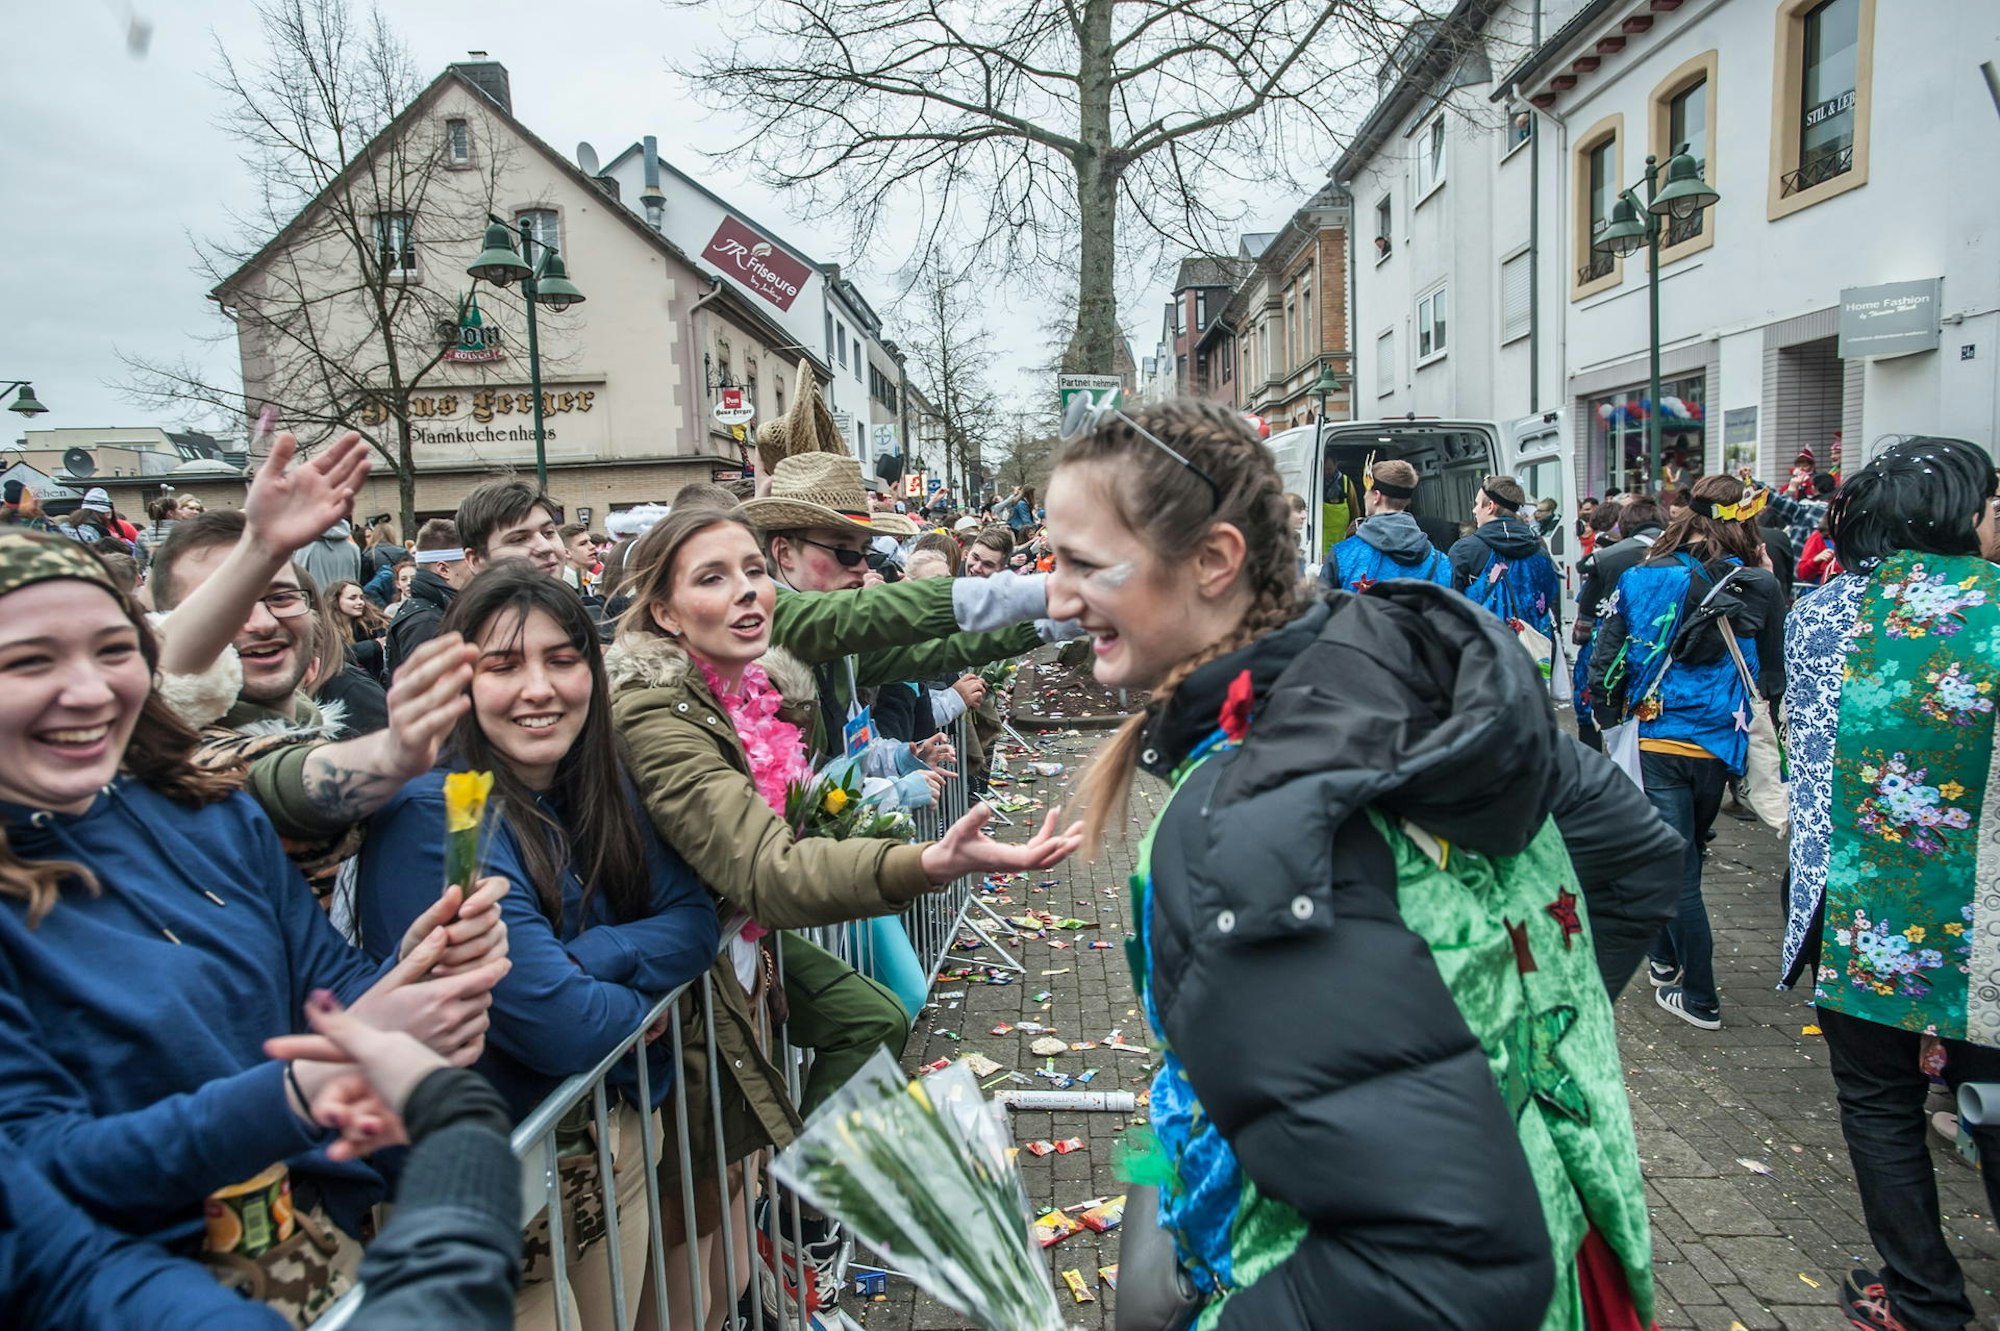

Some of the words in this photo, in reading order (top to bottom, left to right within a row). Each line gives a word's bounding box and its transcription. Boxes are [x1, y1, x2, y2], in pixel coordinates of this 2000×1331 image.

[1807, 106, 1827, 127] STIL
[1828, 101, 1835, 116] &
[712, 238, 748, 270] JR
[746, 256, 797, 296] Friseure
[1846, 301, 1880, 312] Home
[1883, 295, 1930, 308] Fashion
[1061, 378, 1091, 387] Partner
[1093, 379, 1120, 388] nehmen
[361, 393, 459, 425] Hus
